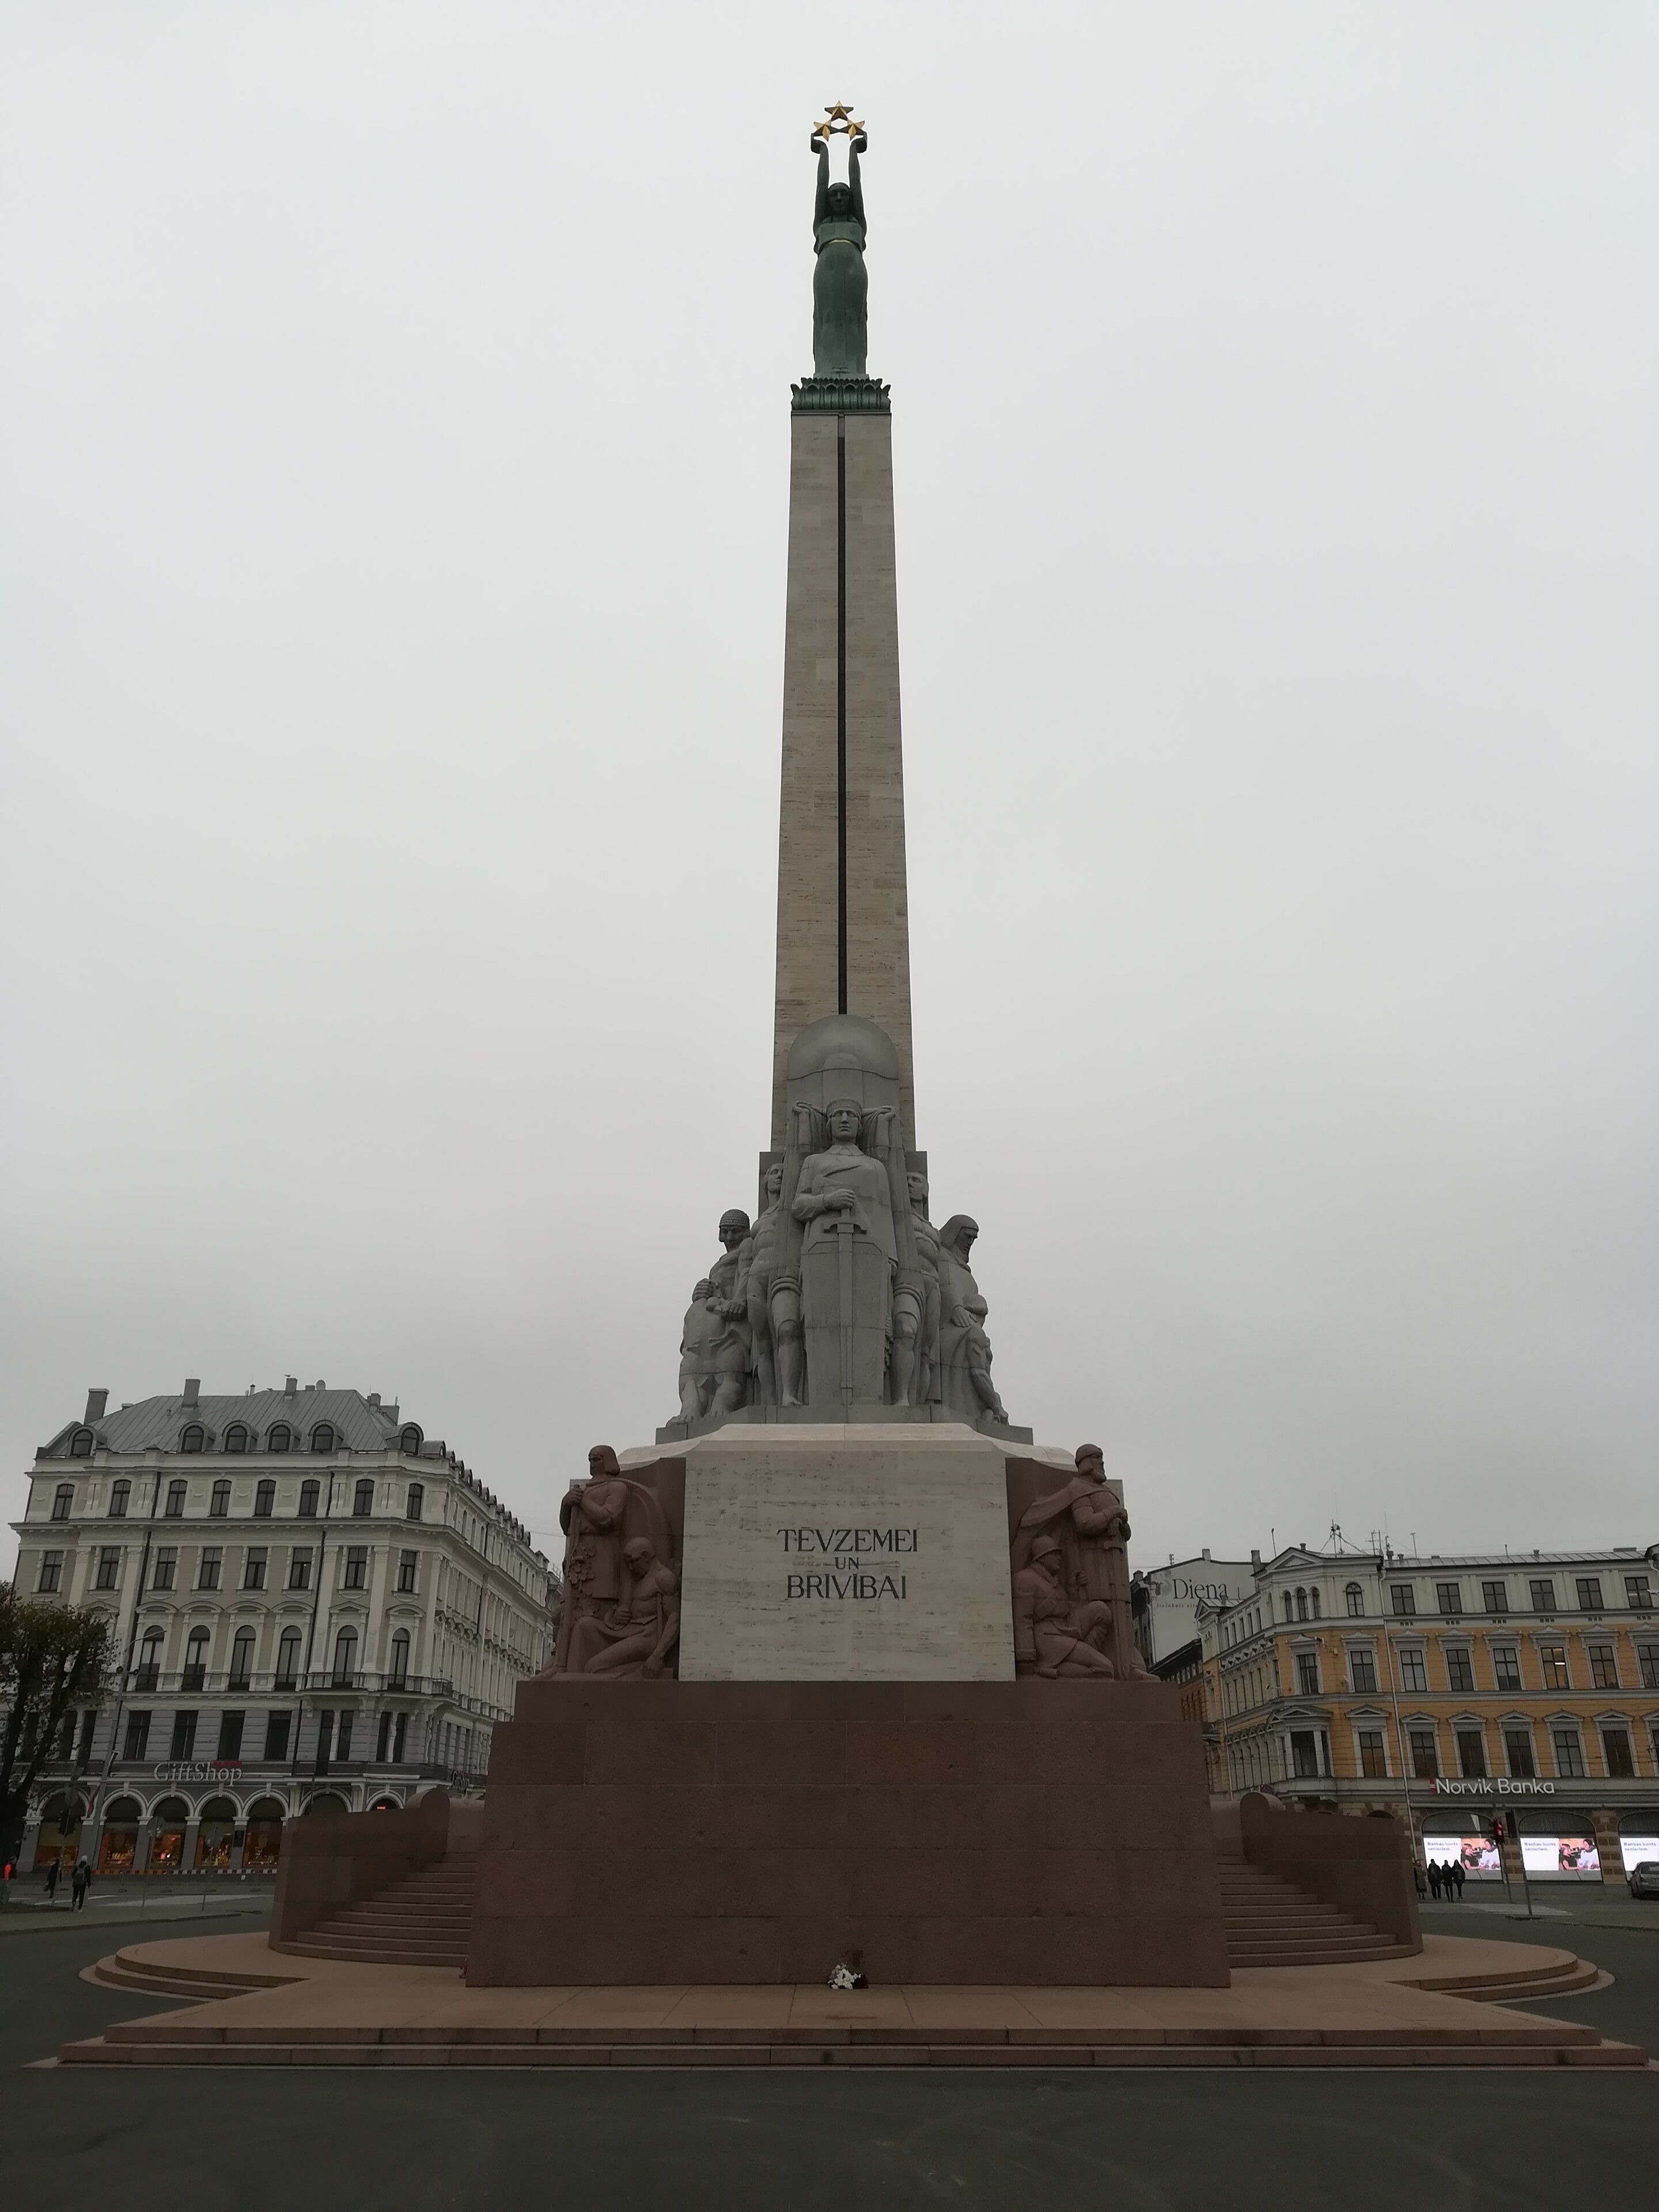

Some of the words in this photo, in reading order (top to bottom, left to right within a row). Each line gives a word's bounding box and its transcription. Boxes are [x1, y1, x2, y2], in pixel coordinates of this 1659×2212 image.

[777, 1527, 918, 1552] TĒVZEMEI
[835, 1556, 859, 1570] UN
[1172, 1578, 1228, 1599] Diena
[154, 1761, 242, 1786] GiftShop
[1435, 1778, 1494, 1794] Norvik
[1497, 1778, 1555, 1794] Banka
